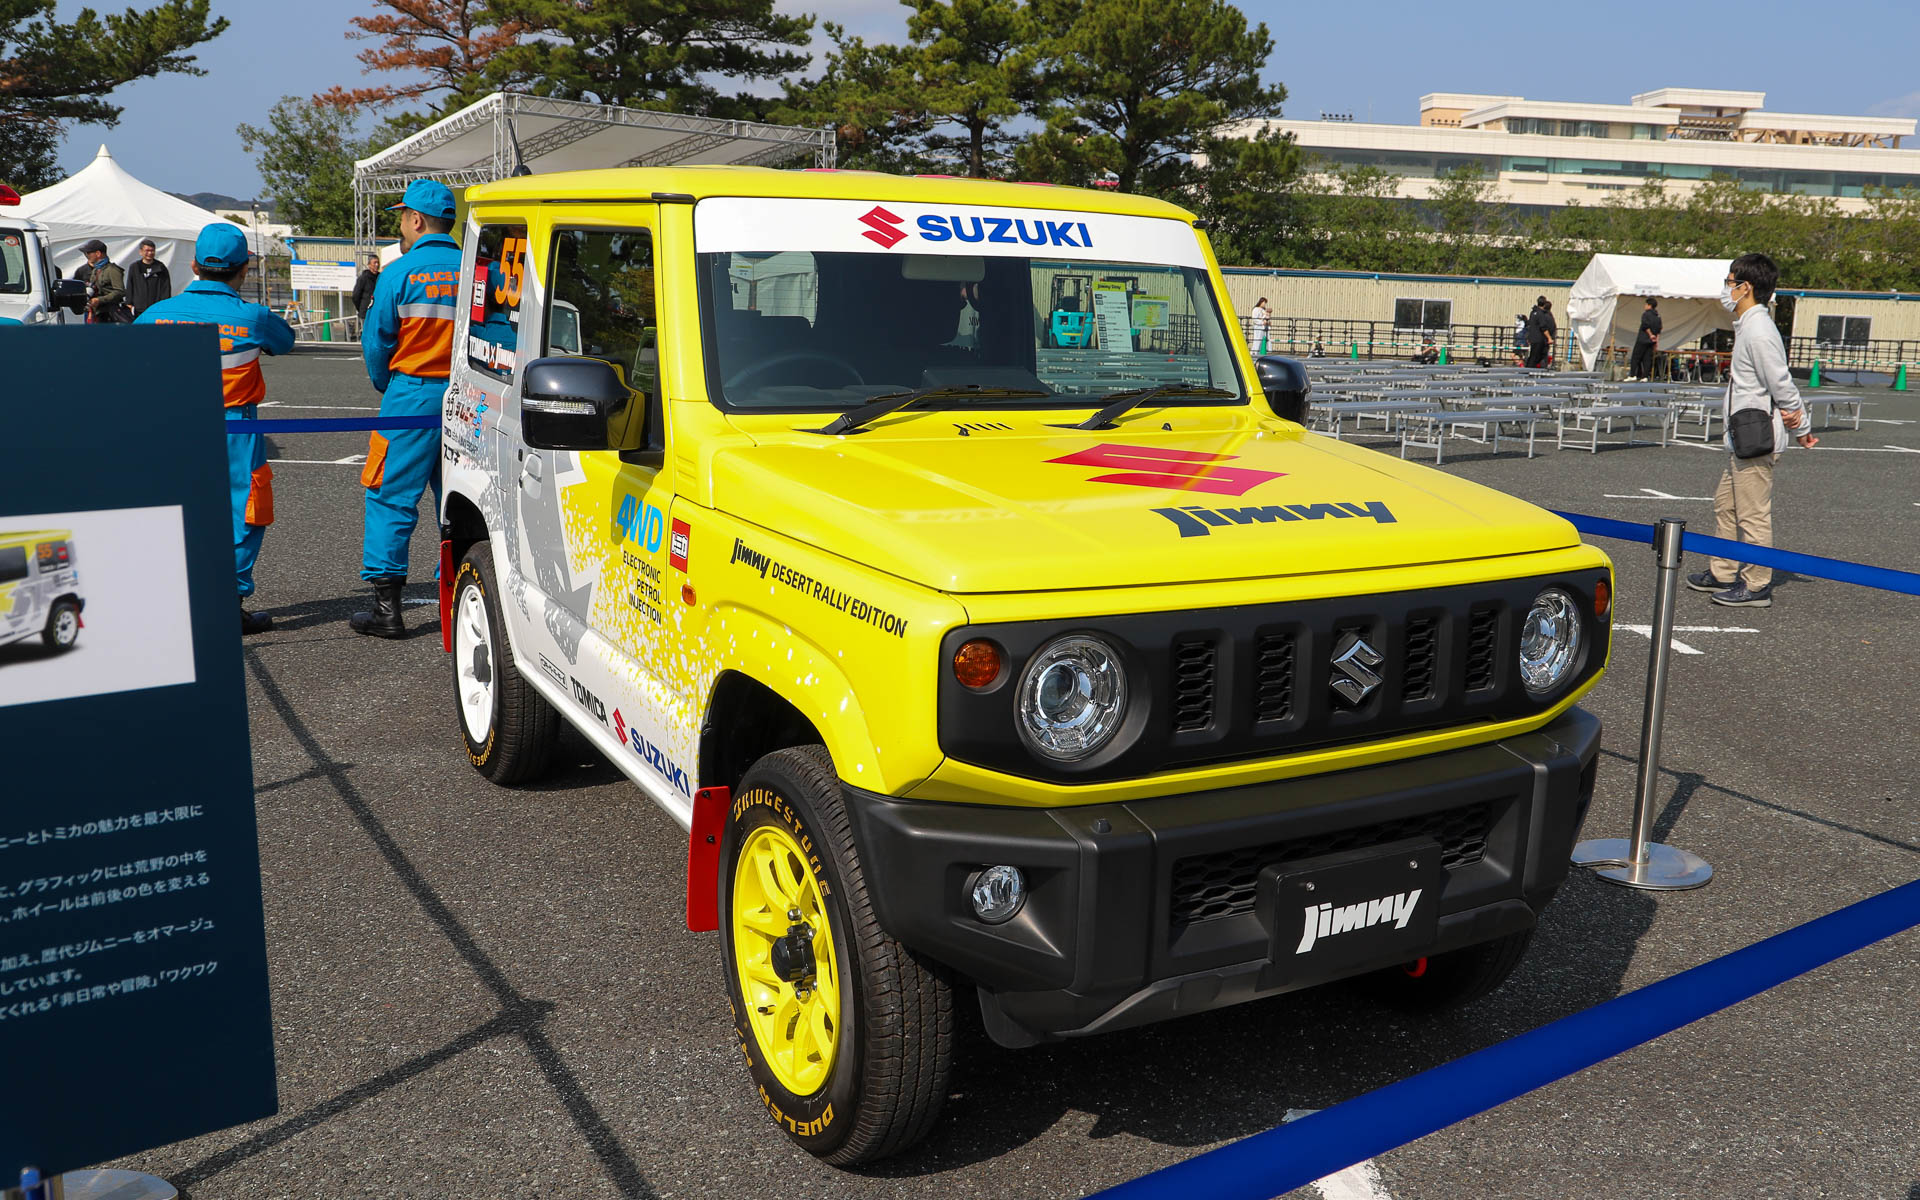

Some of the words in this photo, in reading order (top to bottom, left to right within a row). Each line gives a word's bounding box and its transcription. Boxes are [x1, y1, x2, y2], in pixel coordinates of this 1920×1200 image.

[916, 214, 1093, 248] SUZUKI
[409, 272, 453, 285] POLICE
[495, 238, 527, 307] 55
[617, 493, 663, 553] 4WD
[1149, 501, 1398, 538] Jimny
[623, 551, 661, 584] ELECTRONIC
[637, 580, 661, 605] PETROL
[730, 537, 771, 579] Jimny
[772, 563, 814, 594] DESERT
[813, 581, 853, 614] RALLY
[851, 598, 908, 639] EDITION
[629, 593, 662, 625] INJECTION
[570, 675, 609, 728] TOMICA
[631, 727, 690, 798] SUZUKI
[733, 788, 832, 897] BRIDGESTONE
[0, 872, 210, 923] 、ホイールは前後の色を変える
[1296, 889, 1423, 955] Jimny
[1, 969, 82, 996] しています。
[758, 1085, 834, 1137] DUELER
